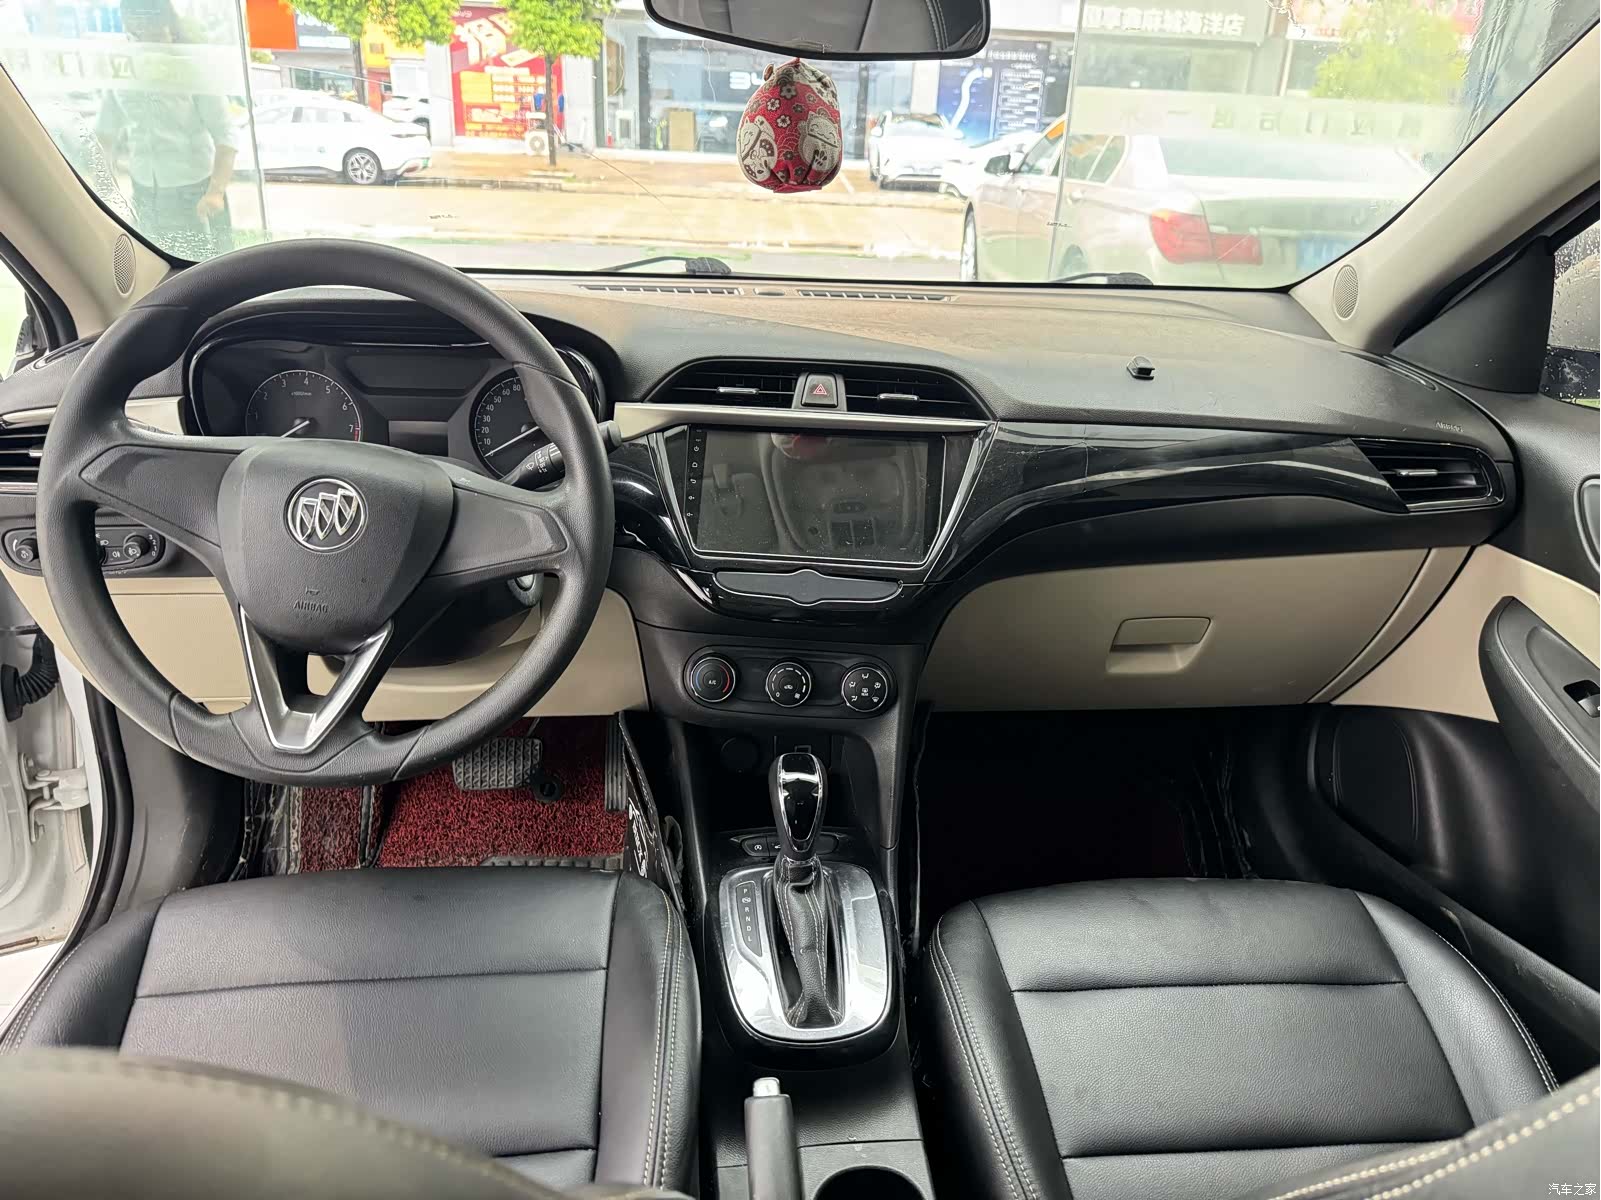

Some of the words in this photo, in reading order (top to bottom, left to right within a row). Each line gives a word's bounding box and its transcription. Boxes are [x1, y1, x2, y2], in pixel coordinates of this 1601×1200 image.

[281, 379, 286, 388] 3
[303, 377, 309, 386] 4
[325, 386, 331, 394] 5
[502, 388, 511, 396] 60
[512, 384, 521, 392] 80
[342, 402, 348, 411] 6
[482, 415, 491, 423] 30
[349, 424, 354, 433] 7
[481, 426, 490, 434] 20
[483, 438, 491, 446] 10
[293, 599, 328, 613] AIRBAG
